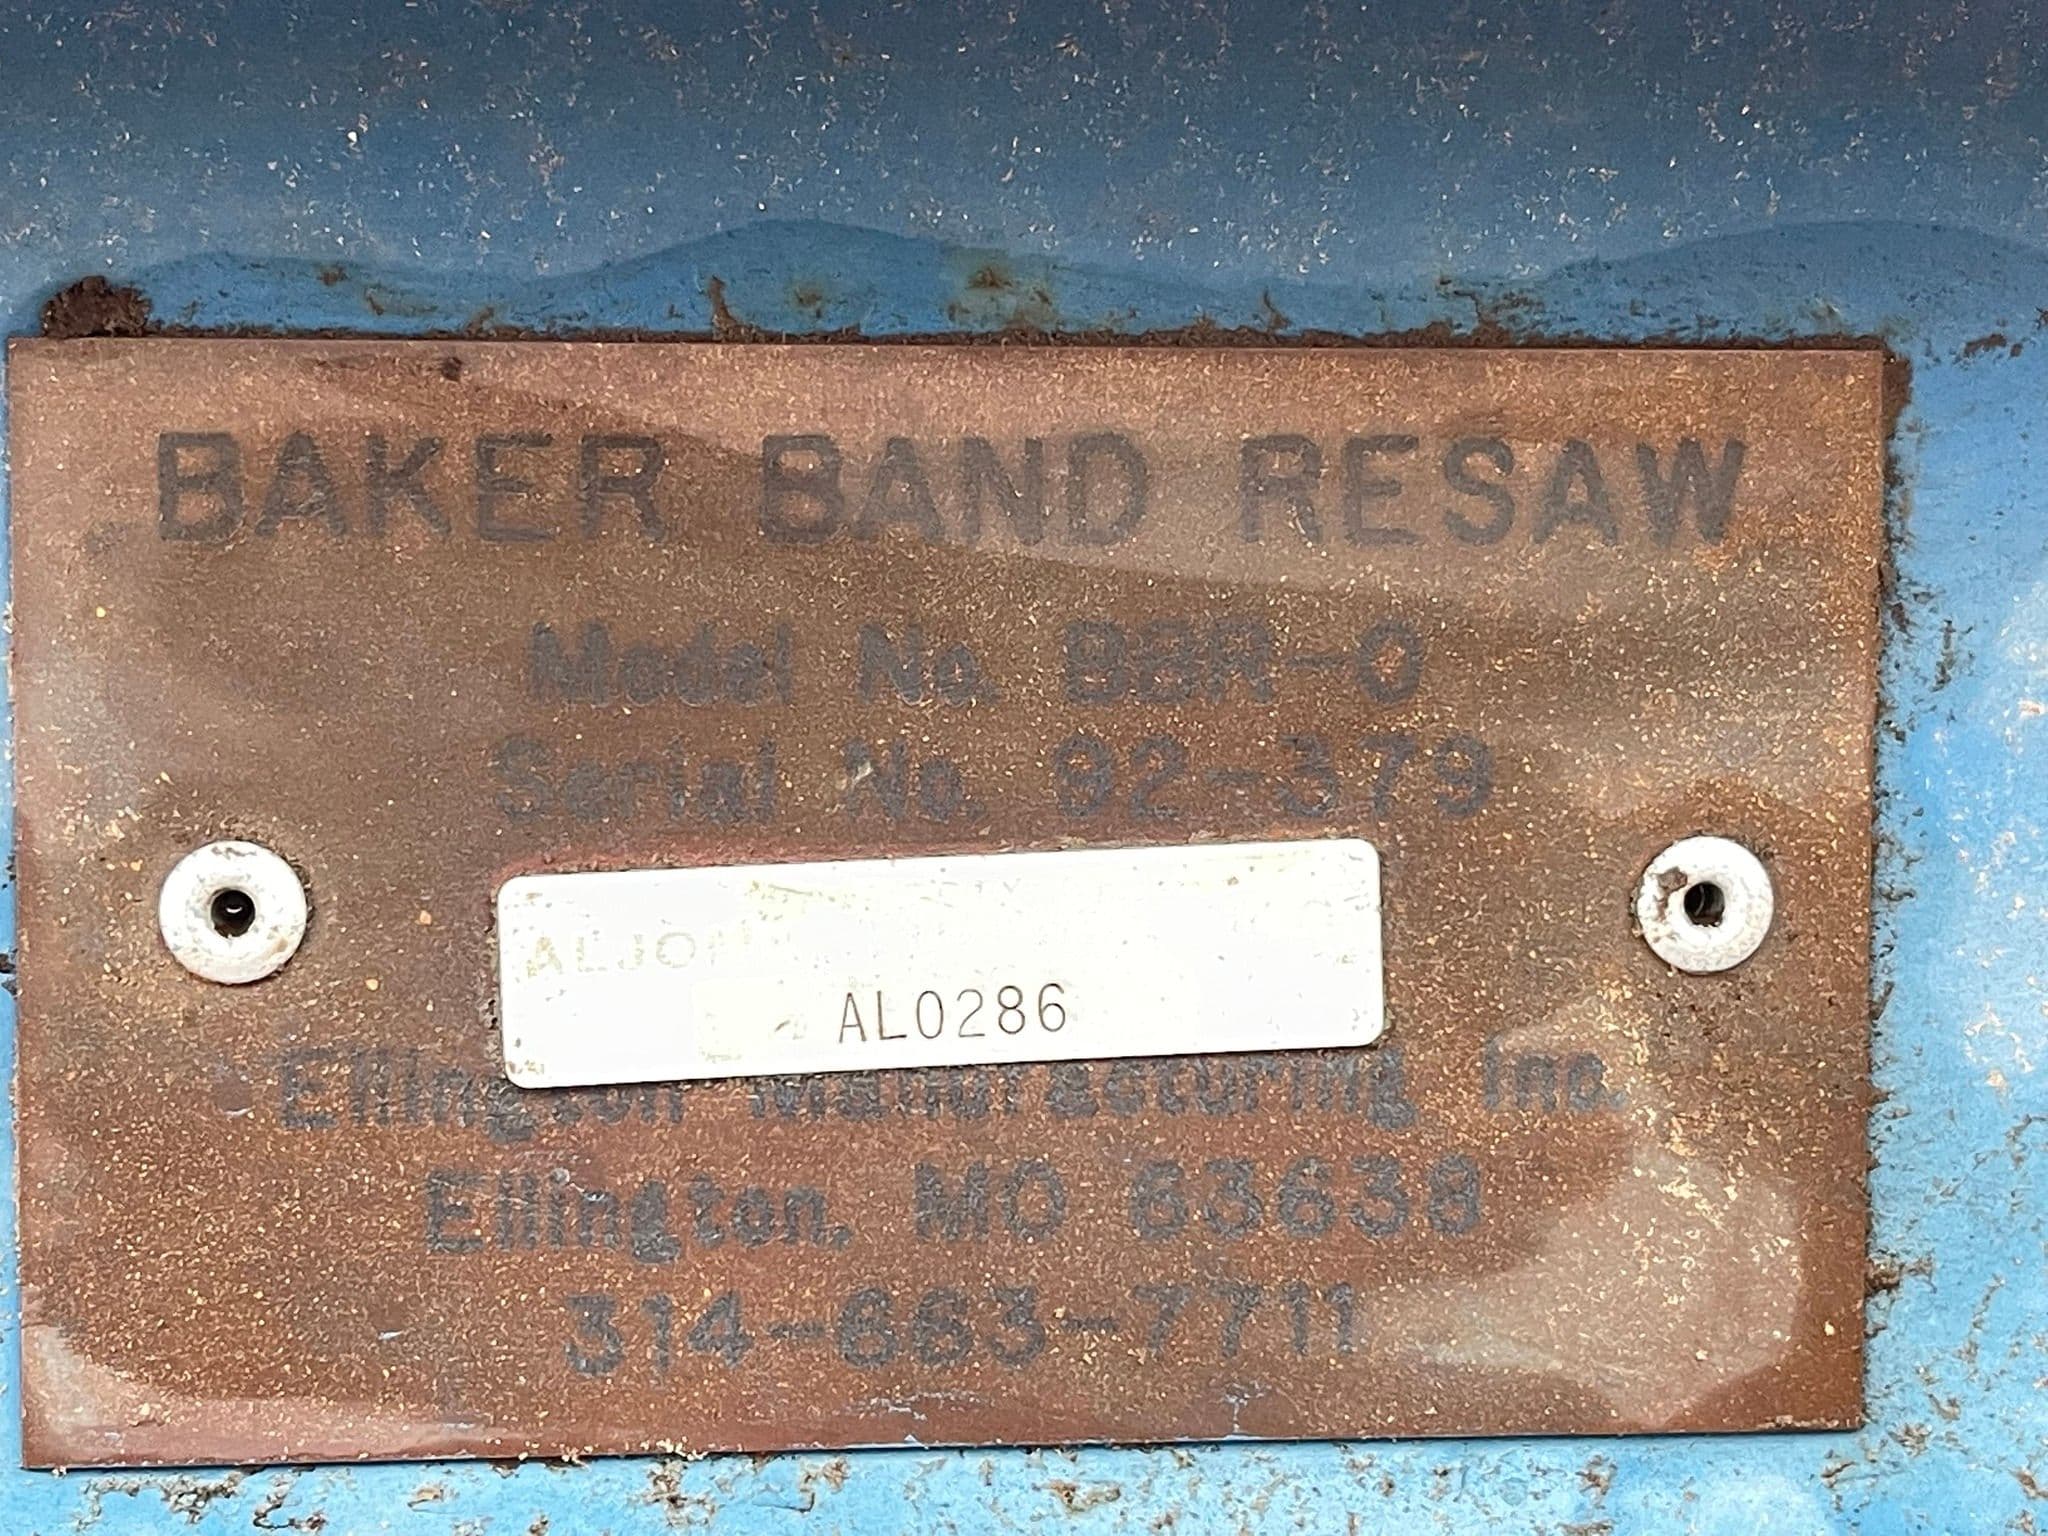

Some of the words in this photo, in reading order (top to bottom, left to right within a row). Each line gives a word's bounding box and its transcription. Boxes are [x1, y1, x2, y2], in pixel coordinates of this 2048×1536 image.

[157, 430, 668, 543] BAKER
[760, 432, 1150, 545] BAND
[1238, 432, 1747, 547] RESAW
[527, 620, 794, 707] Model
[498, 738, 778, 824] Serial
[1055, 734, 1494, 820] 92-379
[1480, 1034, 1632, 1114] Inc.
[914, 1162, 1068, 1242] MO
[1128, 1155, 1484, 1240] 63638
[564, 1284, 1360, 1376] 314-663-7711
